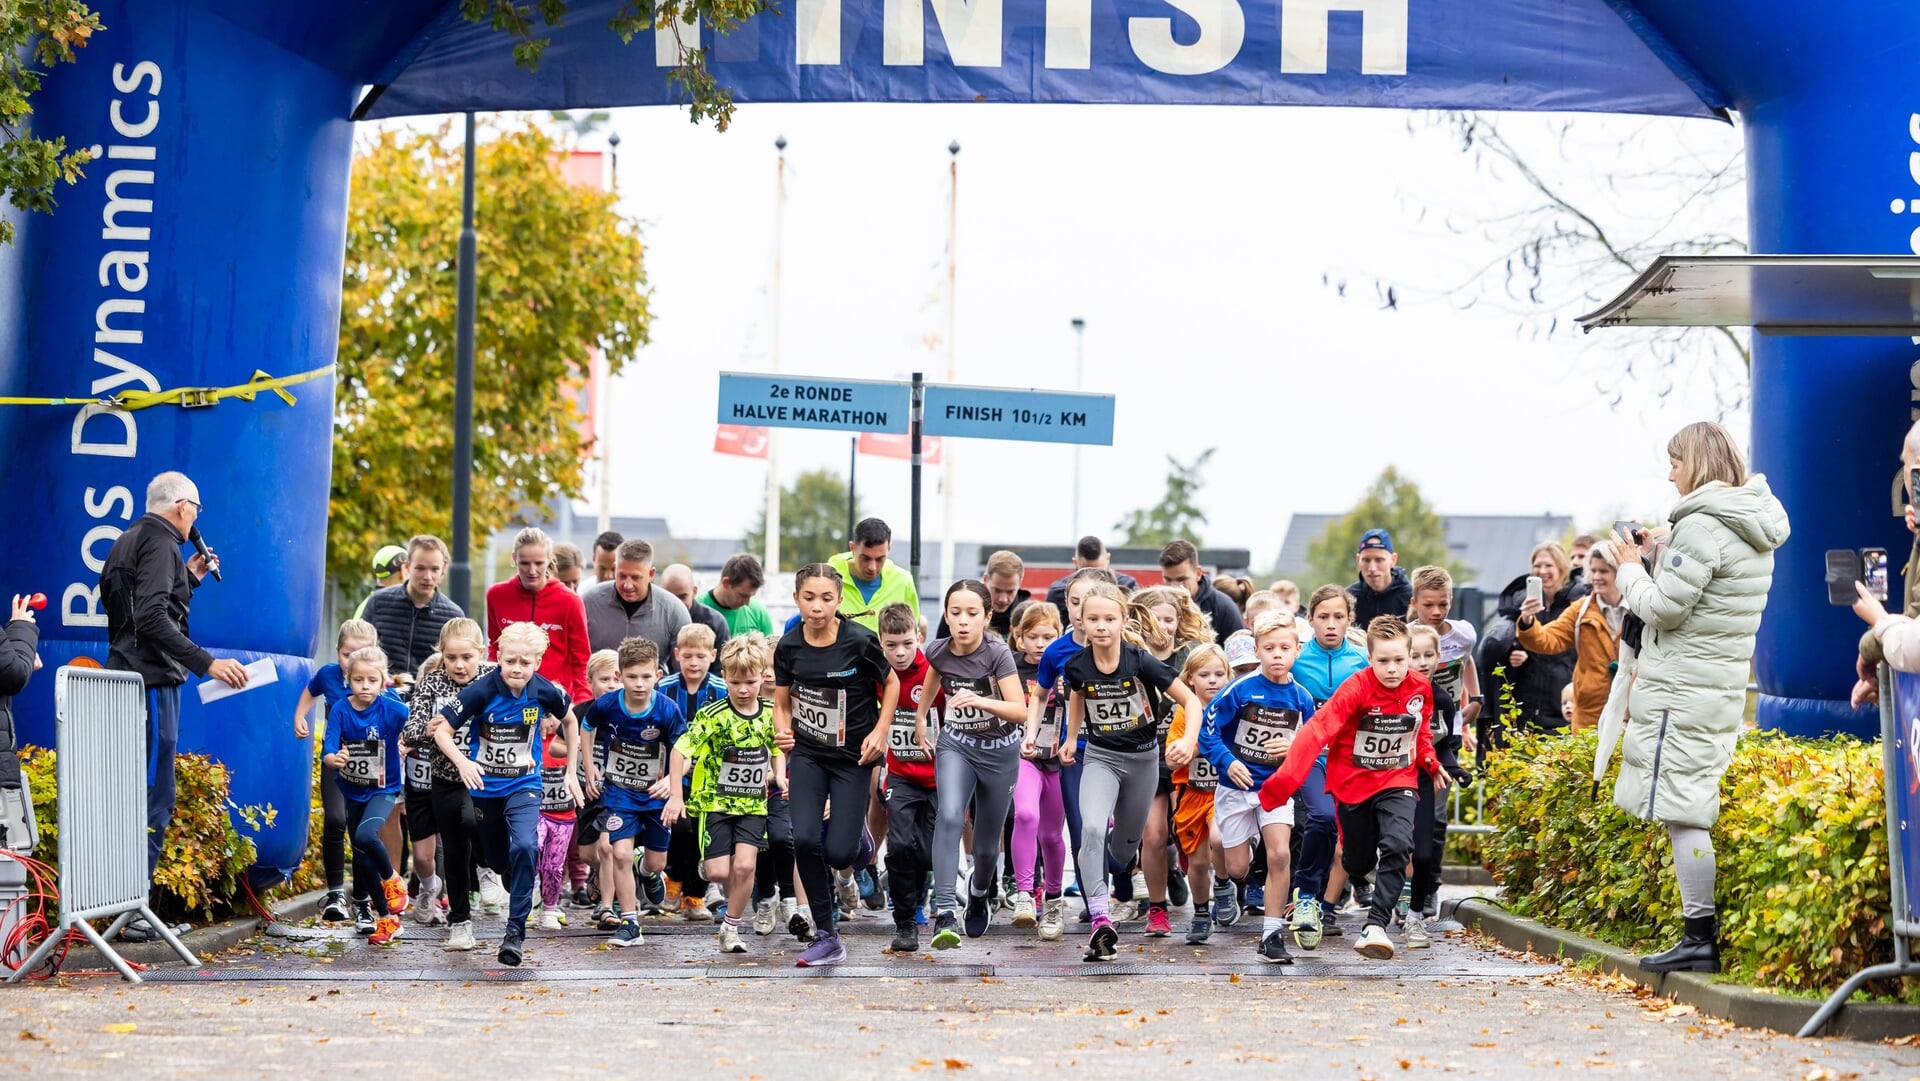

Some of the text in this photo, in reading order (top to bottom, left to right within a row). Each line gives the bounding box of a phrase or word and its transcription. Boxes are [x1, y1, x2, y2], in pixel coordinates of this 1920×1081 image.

[61, 59, 163, 627] Bos Dynamics
[770, 383, 853, 402] 2e RONDE
[733, 403, 888, 427] HALVE MARATHON
[945, 404, 1003, 423] FINISH
[1060, 411, 1087, 427] KM
[488, 713, 495, 723] 6
[799, 702, 828, 729] 500
[1096, 701, 1131, 720] 547
[798, 721, 828, 741] VAN SLOTEN
[965, 721, 990, 730] SLOTEN
[1136, 742, 1153, 751] NIKE
[1240, 746, 1254, 757] VAN
[1364, 736, 1402, 754] 504
[485, 744, 517, 765] 556
[1360, 757, 1401, 765] VAN SLOTEN
[494, 766, 520, 775] SLOTEN
[615, 757, 649, 777] 528
[611, 774, 624, 783] VAN
[624, 778, 648, 787] SLOTEN
[728, 768, 763, 785] 530
[724, 785, 762, 795] VAN SLOTEN
